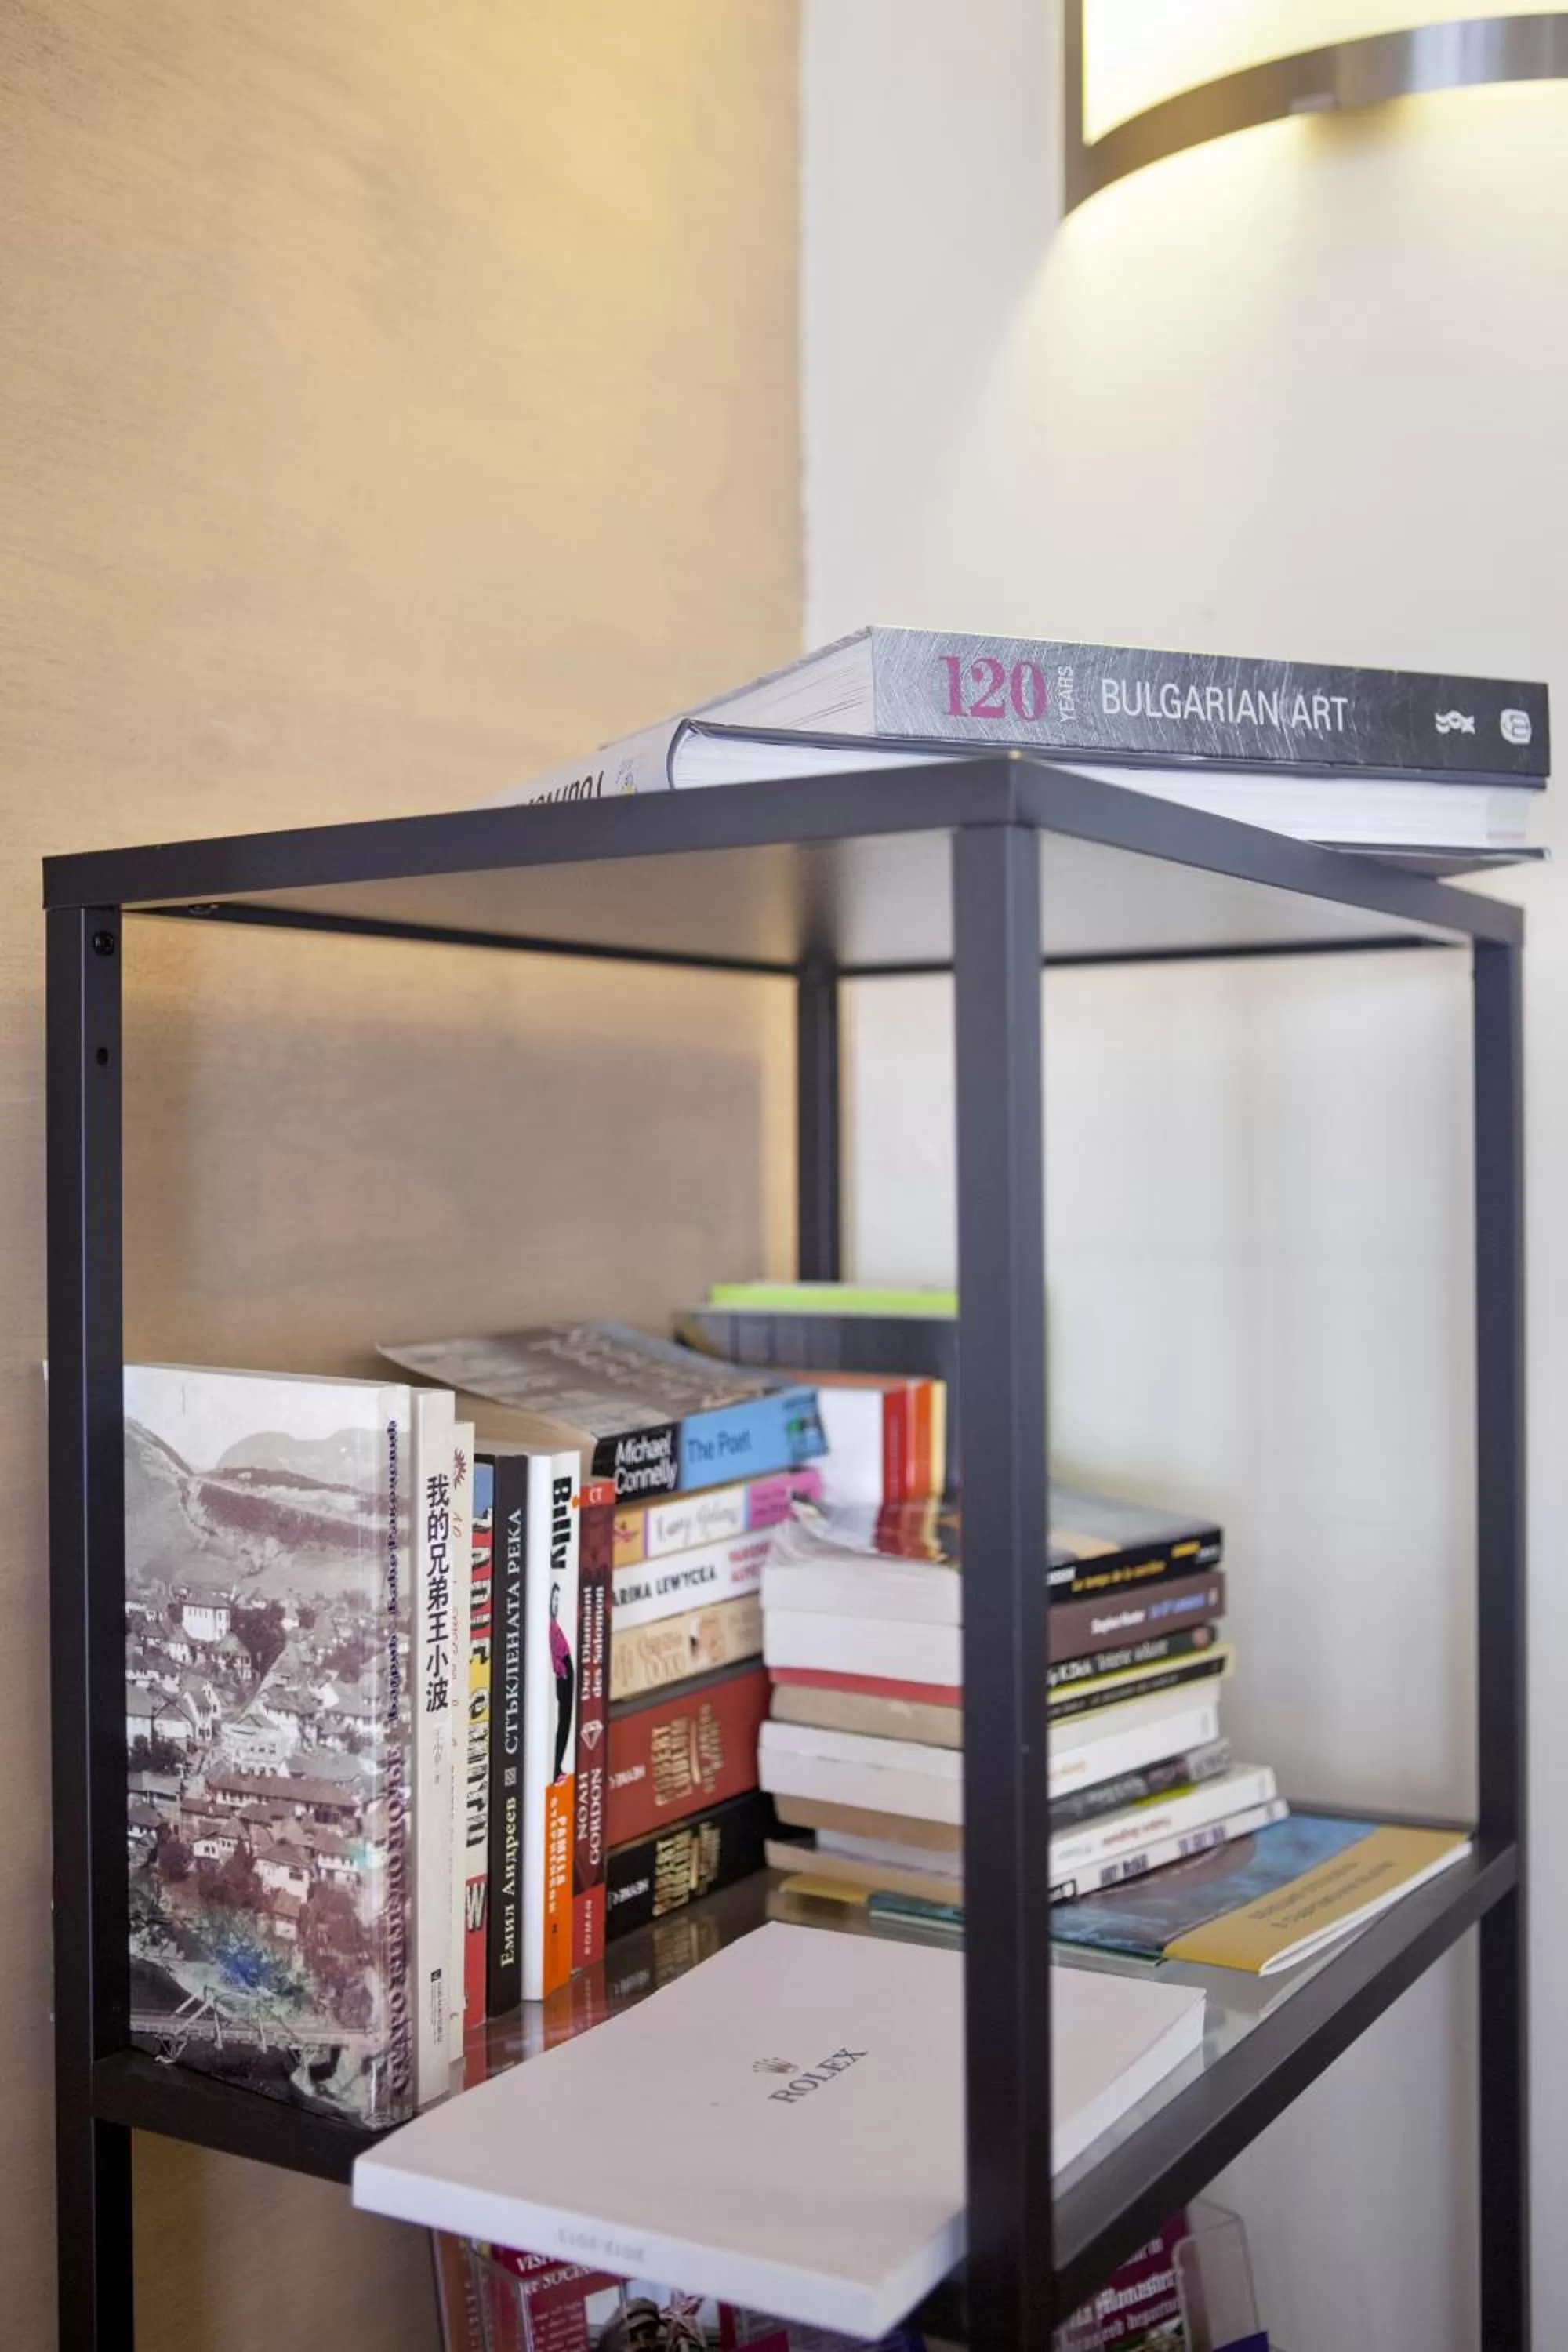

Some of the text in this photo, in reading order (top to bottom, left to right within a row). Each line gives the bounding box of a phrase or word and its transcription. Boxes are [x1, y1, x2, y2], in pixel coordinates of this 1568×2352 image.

[939, 655, 1047, 723] 120
[1058, 665, 1075, 727] YEARS
[1102, 678, 1348, 732] BULGARIAN ART
[614, 1455, 679, 1495] Connelly
[615, 1429, 673, 1465] Michael
[687, 1436, 716, 1462] The
[550, 1475, 573, 1570] Billy
[426, 1472, 450, 1713] 我的兄弟王小波
[505, 1508, 523, 1755] СТЪКЛЕНАТА РЕКА
[576, 1772, 589, 1841] NOAH
[590, 1767, 603, 1866] GORDON
[500, 1796, 521, 1966] Емил Андреев
[767, 2047, 869, 2104] ROLEX
